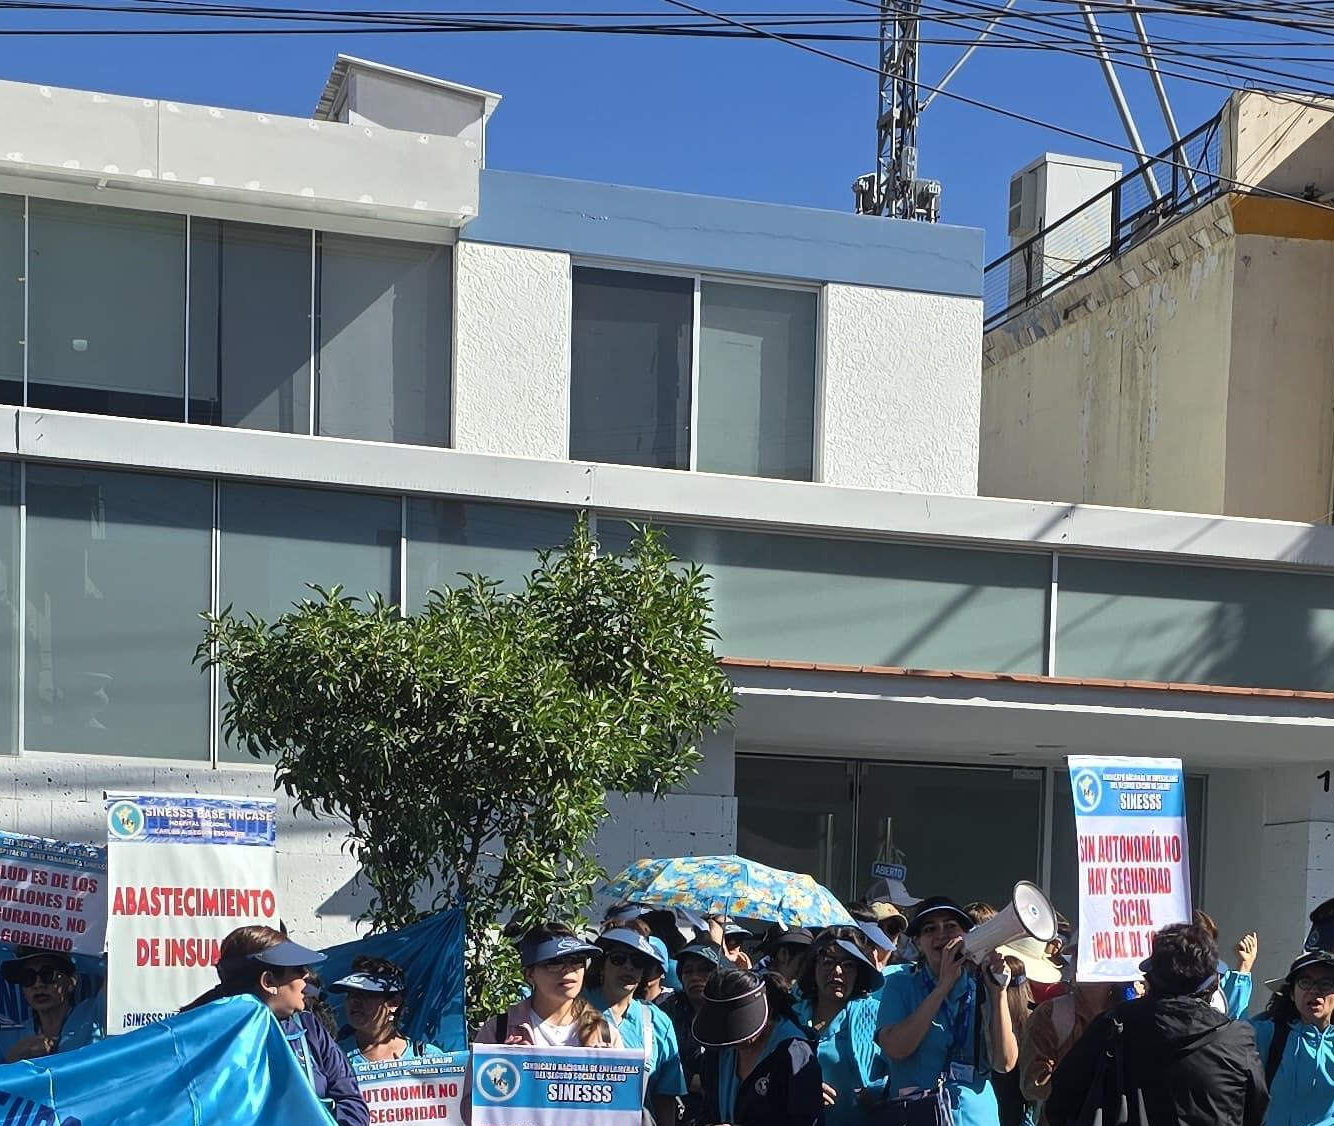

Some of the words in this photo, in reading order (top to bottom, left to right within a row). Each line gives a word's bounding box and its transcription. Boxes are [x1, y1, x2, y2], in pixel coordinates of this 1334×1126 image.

[1120, 793, 1162, 810] SINESSS
[146, 807, 194, 818] SINESSS
[197, 808, 225, 820] BASE
[1080, 835, 1096, 863] SIN
[1098, 830, 1163, 863] AUTONOMÍA
[1165, 835, 1181, 863] NO
[875, 865, 903, 878] ABIERTO
[31, 869, 47, 886] ES
[51, 872, 68, 889] DE
[72, 875, 98, 894] LOS
[1088, 868, 1108, 896] HAY
[1110, 867, 1172, 895] SEGURIDAD
[65, 896, 84, 912] DE
[112, 886, 276, 918] ABASTECIMIENTO
[1112, 899, 1154, 927] SOCIAL
[66, 917, 86, 934] NO
[1, 928, 73, 951] GOBIERNO
[1092, 932, 1112, 963] ¡NO
[1114, 932, 1129, 959] AL
[1130, 931, 1144, 957] DL
[136, 938, 161, 967] DE
[123, 1011, 164, 1028] ¡SINESSS
[439, 1083, 458, 1098] NO
[547, 1083, 612, 1102] SINESSS
[369, 1105, 446, 1123] SEGURIDAD
